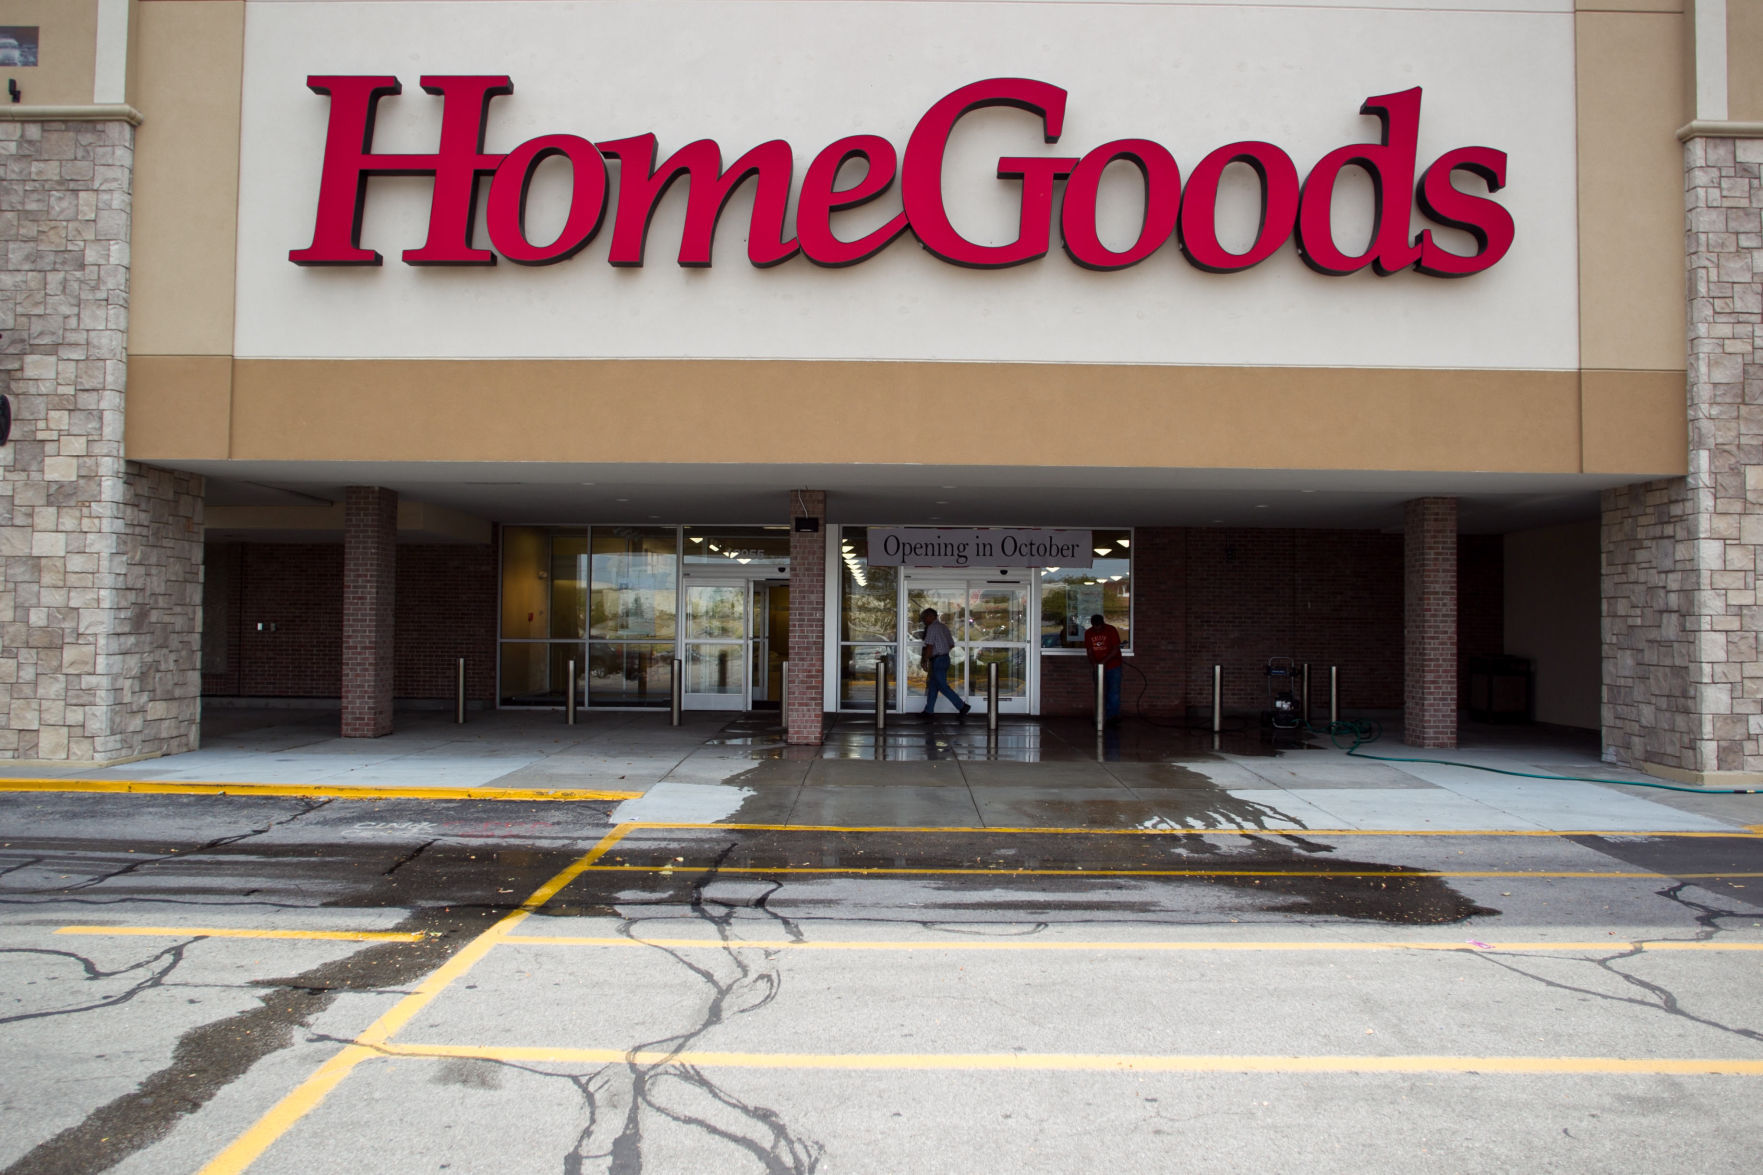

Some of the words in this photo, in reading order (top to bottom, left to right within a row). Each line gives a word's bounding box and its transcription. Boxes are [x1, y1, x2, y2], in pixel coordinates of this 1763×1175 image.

[289, 75, 1515, 276] HomeGoods
[883, 534, 969, 564] Opening
[975, 535, 993, 557] in
[1000, 535, 1080, 558] October
